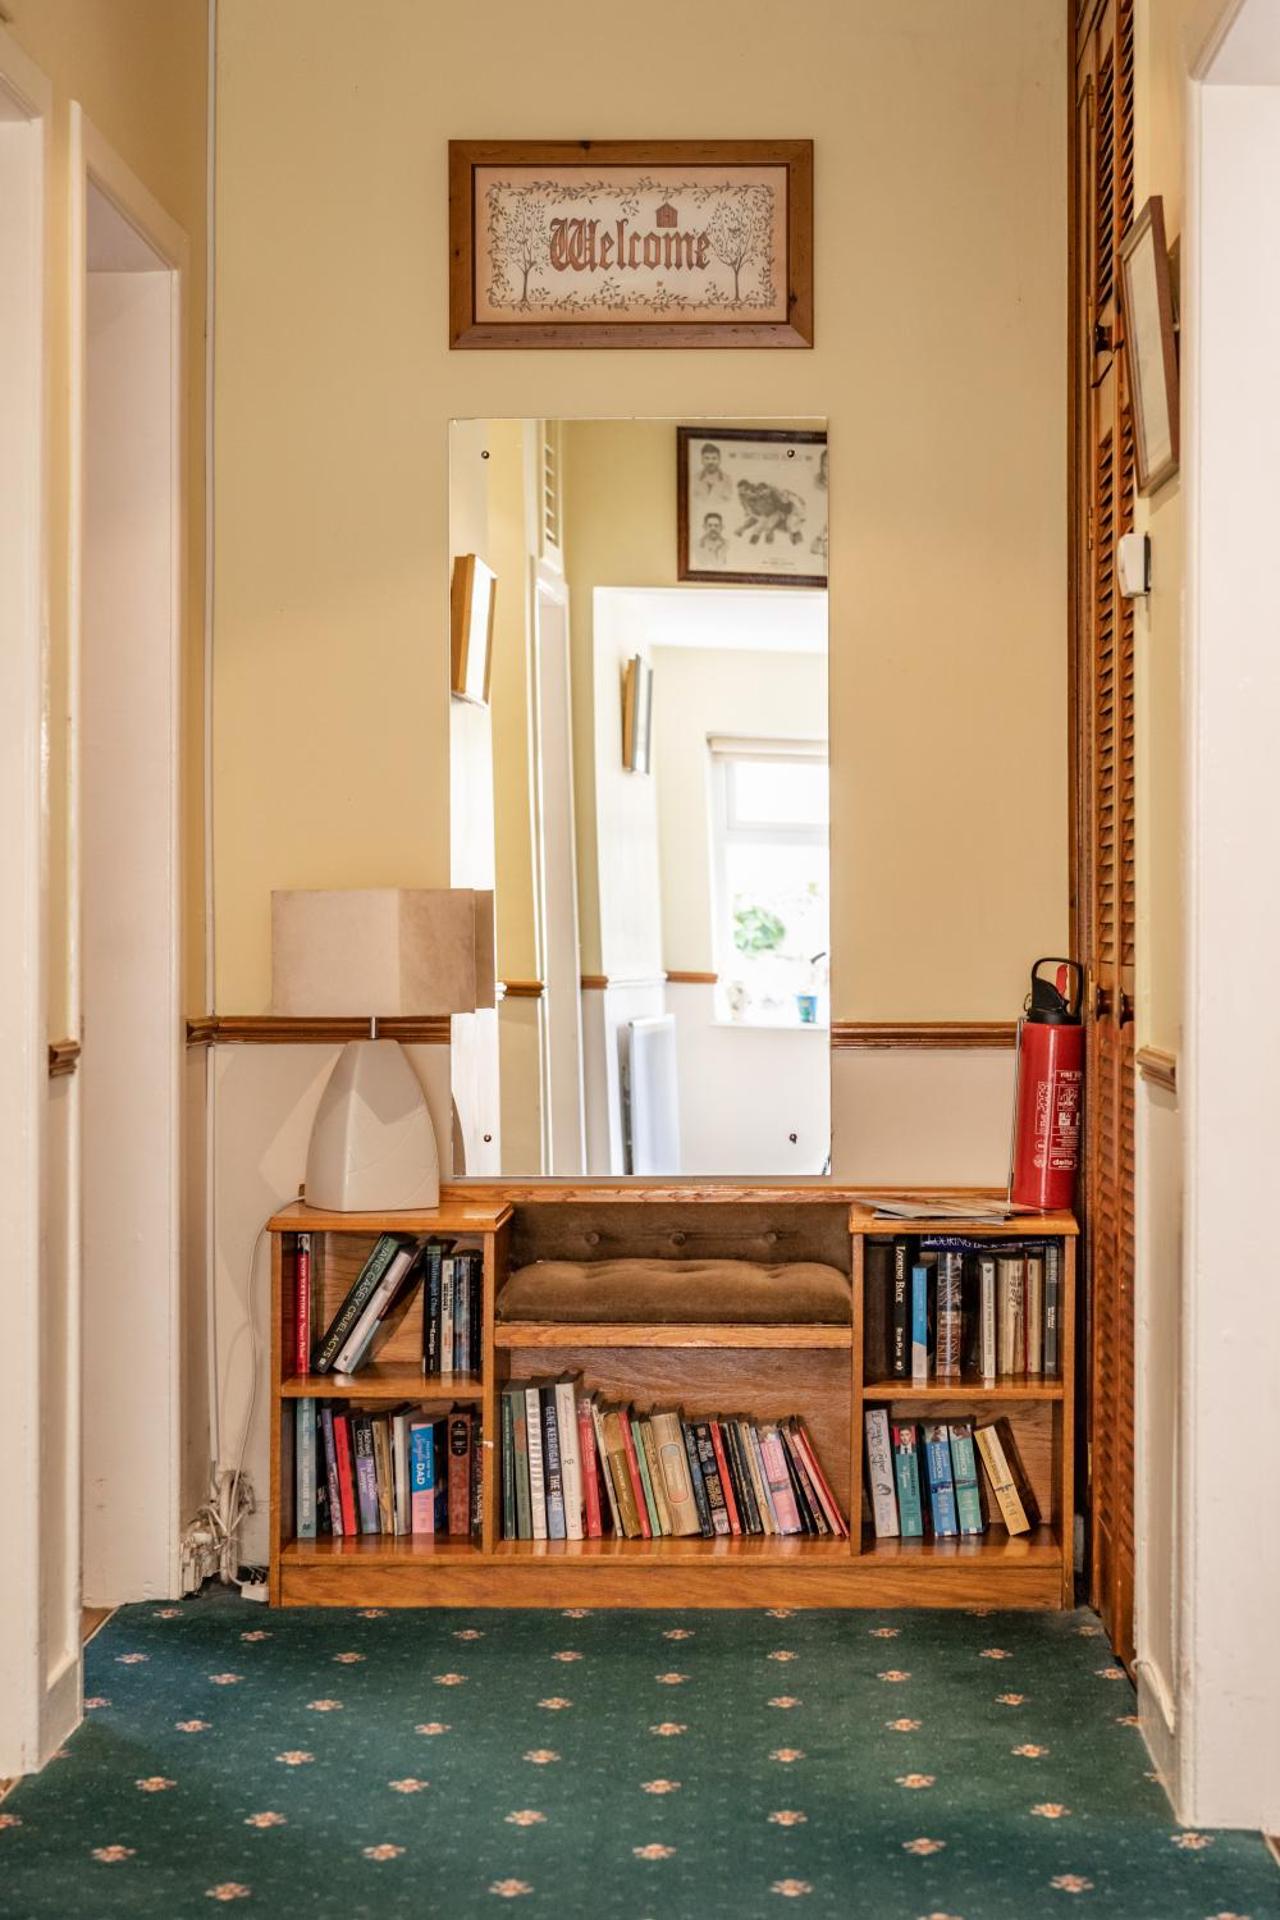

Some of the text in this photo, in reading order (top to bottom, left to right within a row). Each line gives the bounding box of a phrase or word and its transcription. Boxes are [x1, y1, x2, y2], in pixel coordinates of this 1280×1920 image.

[549, 216, 711, 273] Welcome
[351, 1244, 392, 1306] JANE CASEY
[896, 1246, 905, 1303] LOOKING BACK
[322, 1304, 358, 1359] CRUEL ACTS
[545, 1406, 559, 1470] GENE KERRIGAN
[416, 1463, 425, 1485] DAD
[550, 1474, 561, 1489] THE
